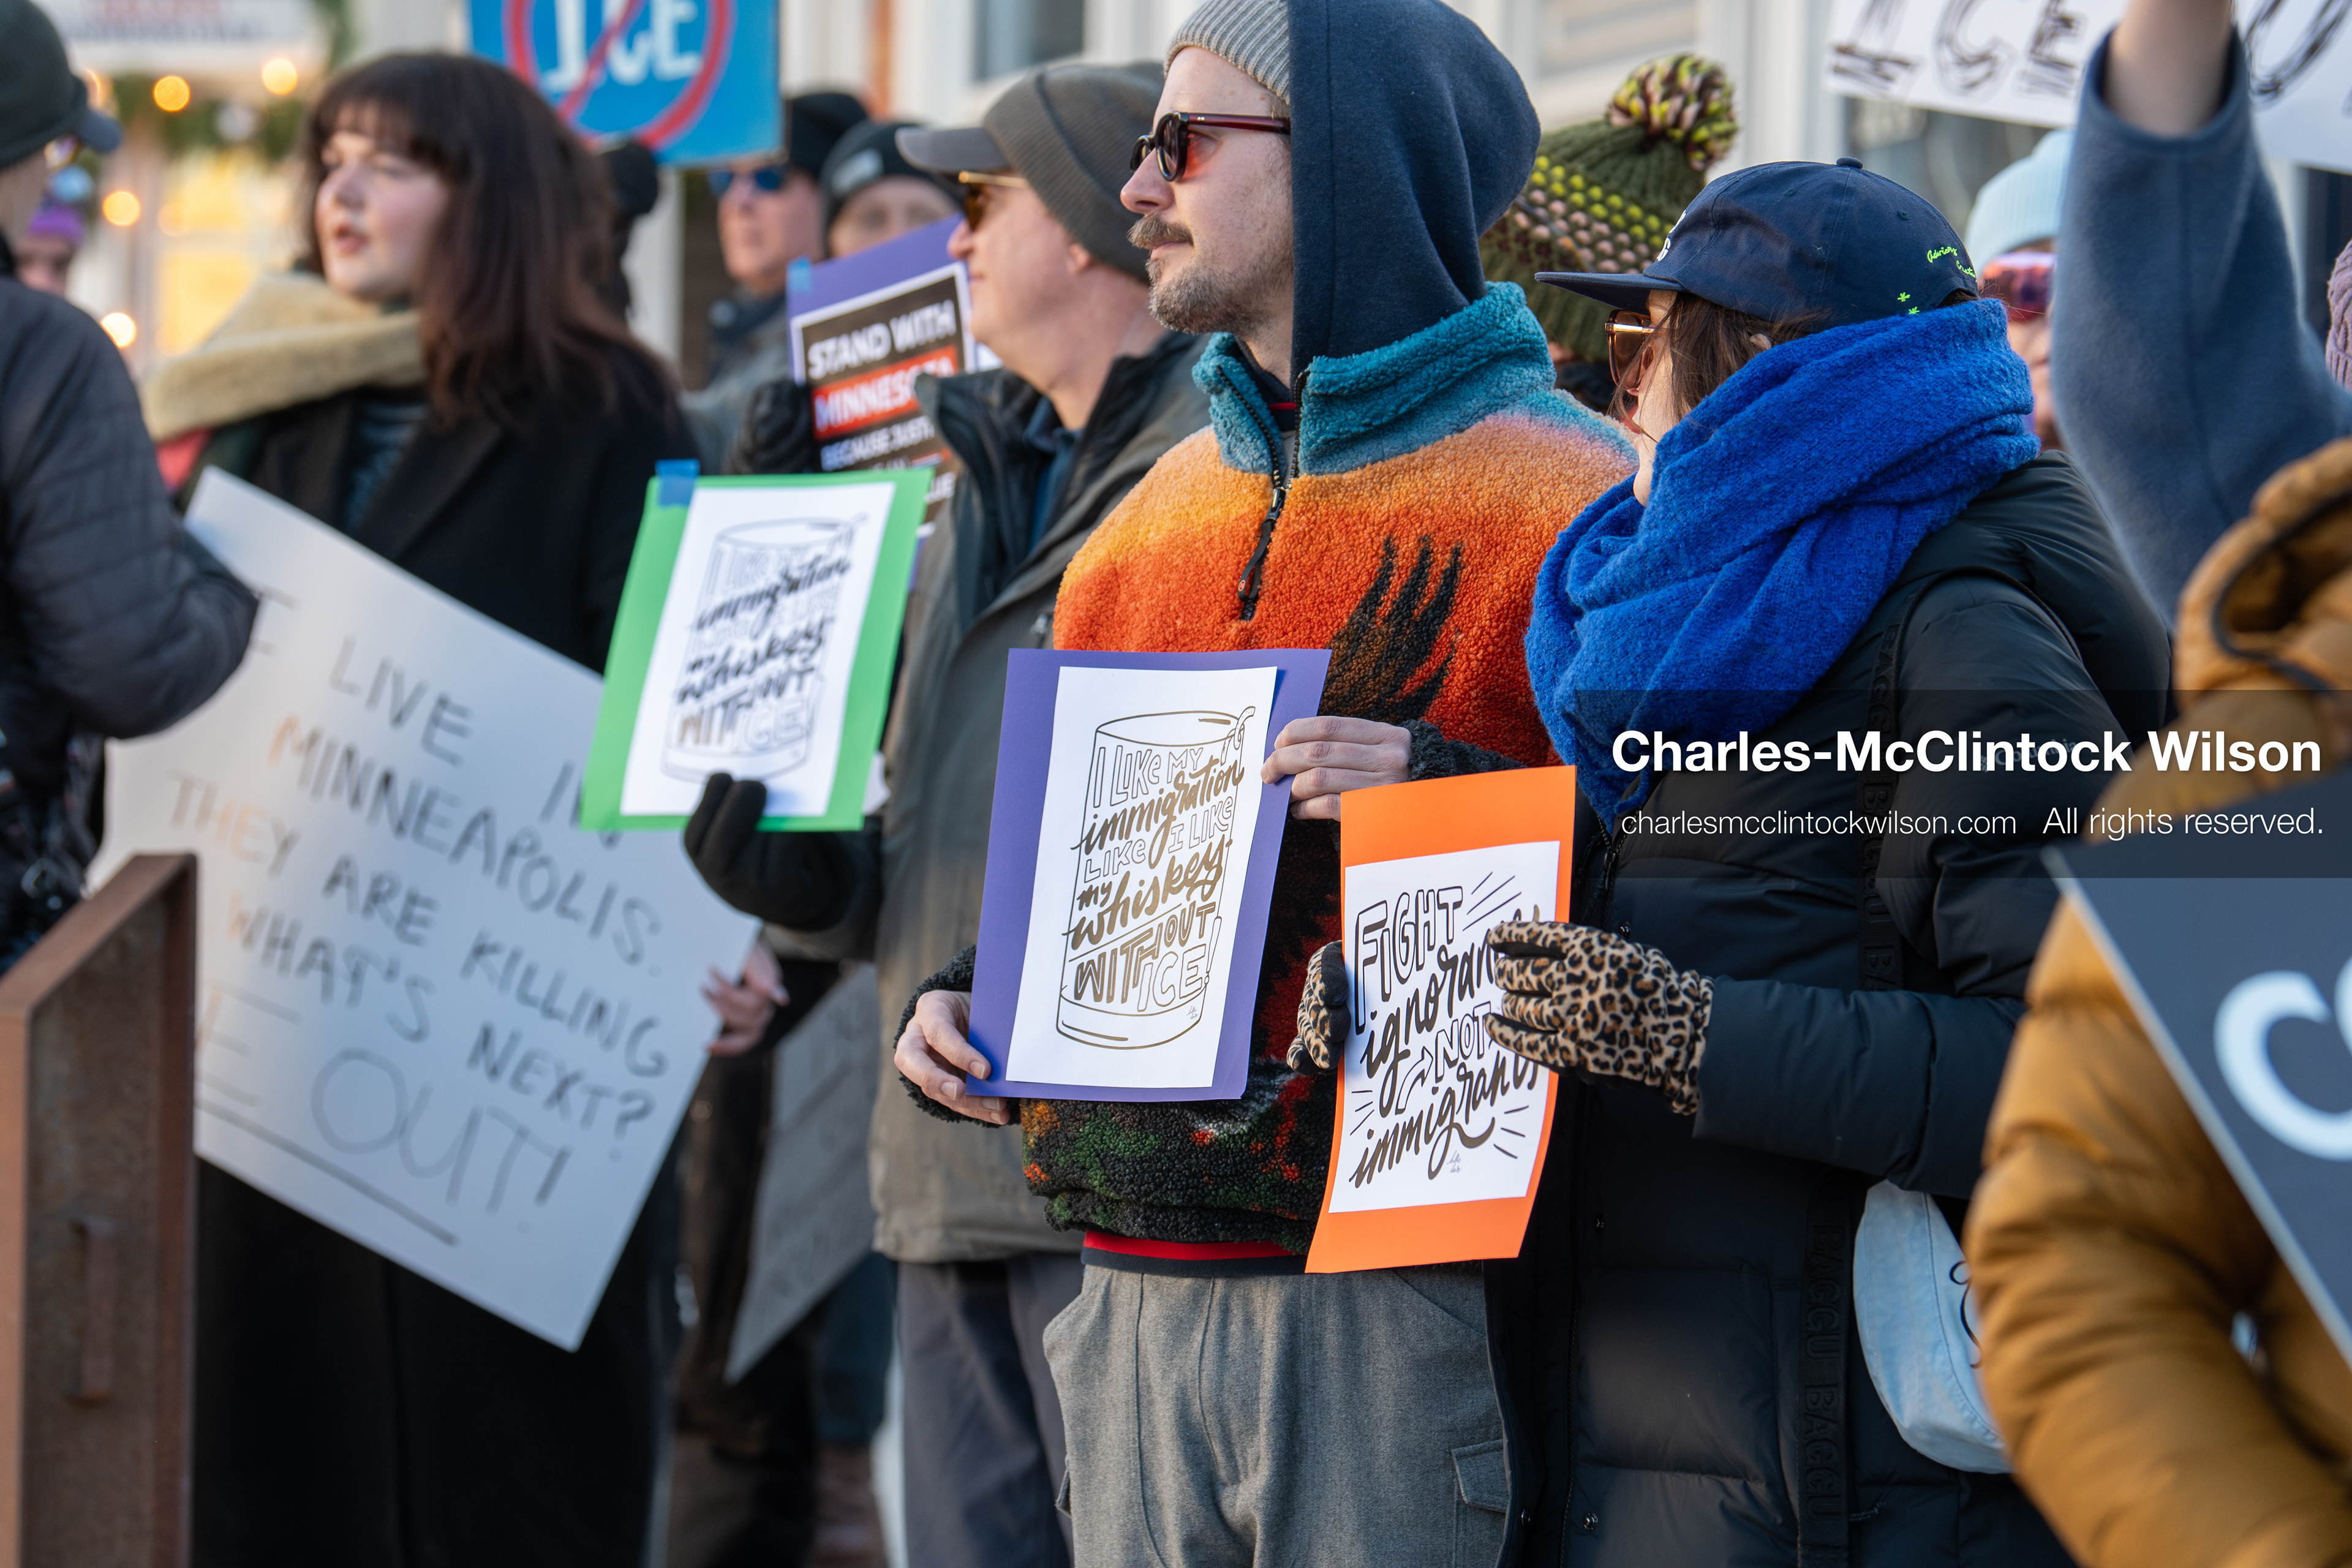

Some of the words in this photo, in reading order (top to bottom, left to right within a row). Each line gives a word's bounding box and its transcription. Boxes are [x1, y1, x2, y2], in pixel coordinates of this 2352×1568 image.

[807, 322, 892, 380] STAND
[889, 299, 957, 353] WITH
[329, 634, 473, 767] LIVE
[1070, 755, 1245, 869] immigration
[1093, 747, 1106, 808] I
[1167, 747, 1204, 783] MY
[1168, 823, 1184, 853] I
[267, 712, 663, 978] MINNEAPOLIS.
[1061, 834, 1233, 950] whiskey
[1076, 881, 1113, 911] my
[169, 767, 300, 878] THEY
[322, 853, 440, 946] ARE
[459, 927, 669, 1078] KILLING
[1073, 901, 1216, 1004] WITHOUT
[1137, 916, 1223, 1012] ICE!
[1355, 886, 1463, 1035] FIGHT
[225, 889, 437, 1043] WHAT'S
[466, 1019, 656, 1163] NEXT?
[1360, 905, 1540, 1118] ignoran
[1434, 1001, 1491, 1083] NOT
[310, 1047, 572, 1233] OUT!
[1805, 1225, 1845, 1362] BAGGU
[1802, 1383, 1843, 1523] BAGGU
